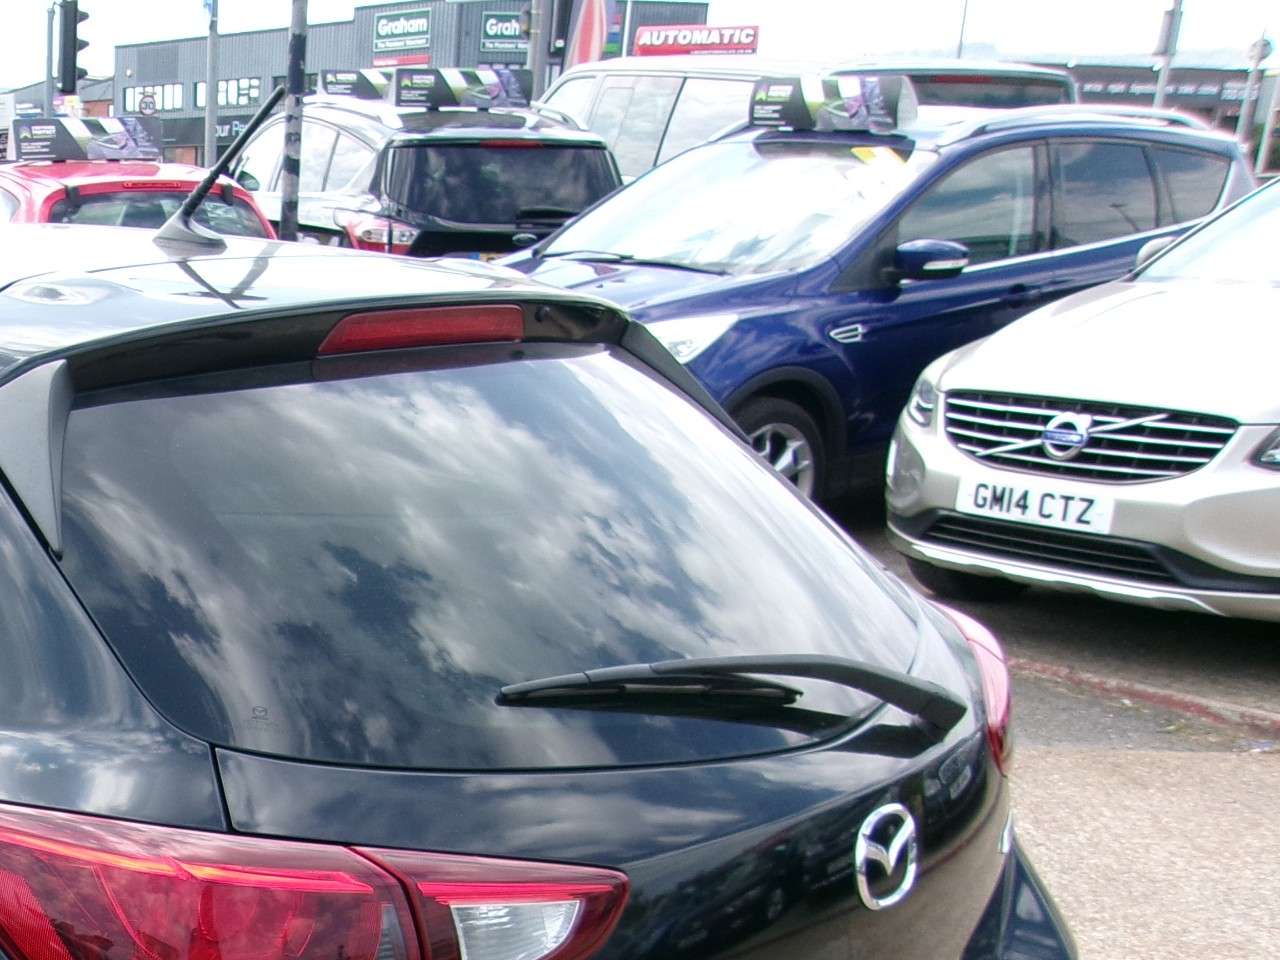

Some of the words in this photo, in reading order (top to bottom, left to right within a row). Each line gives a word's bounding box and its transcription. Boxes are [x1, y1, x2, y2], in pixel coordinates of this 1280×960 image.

[377, 17, 428, 36] Graham
[485, 19, 520, 36] Grah
[640, 28, 754, 46] AUTOMATIC
[973, 483, 1029, 516] GM14
[1039, 493, 1096, 525] CTZ
